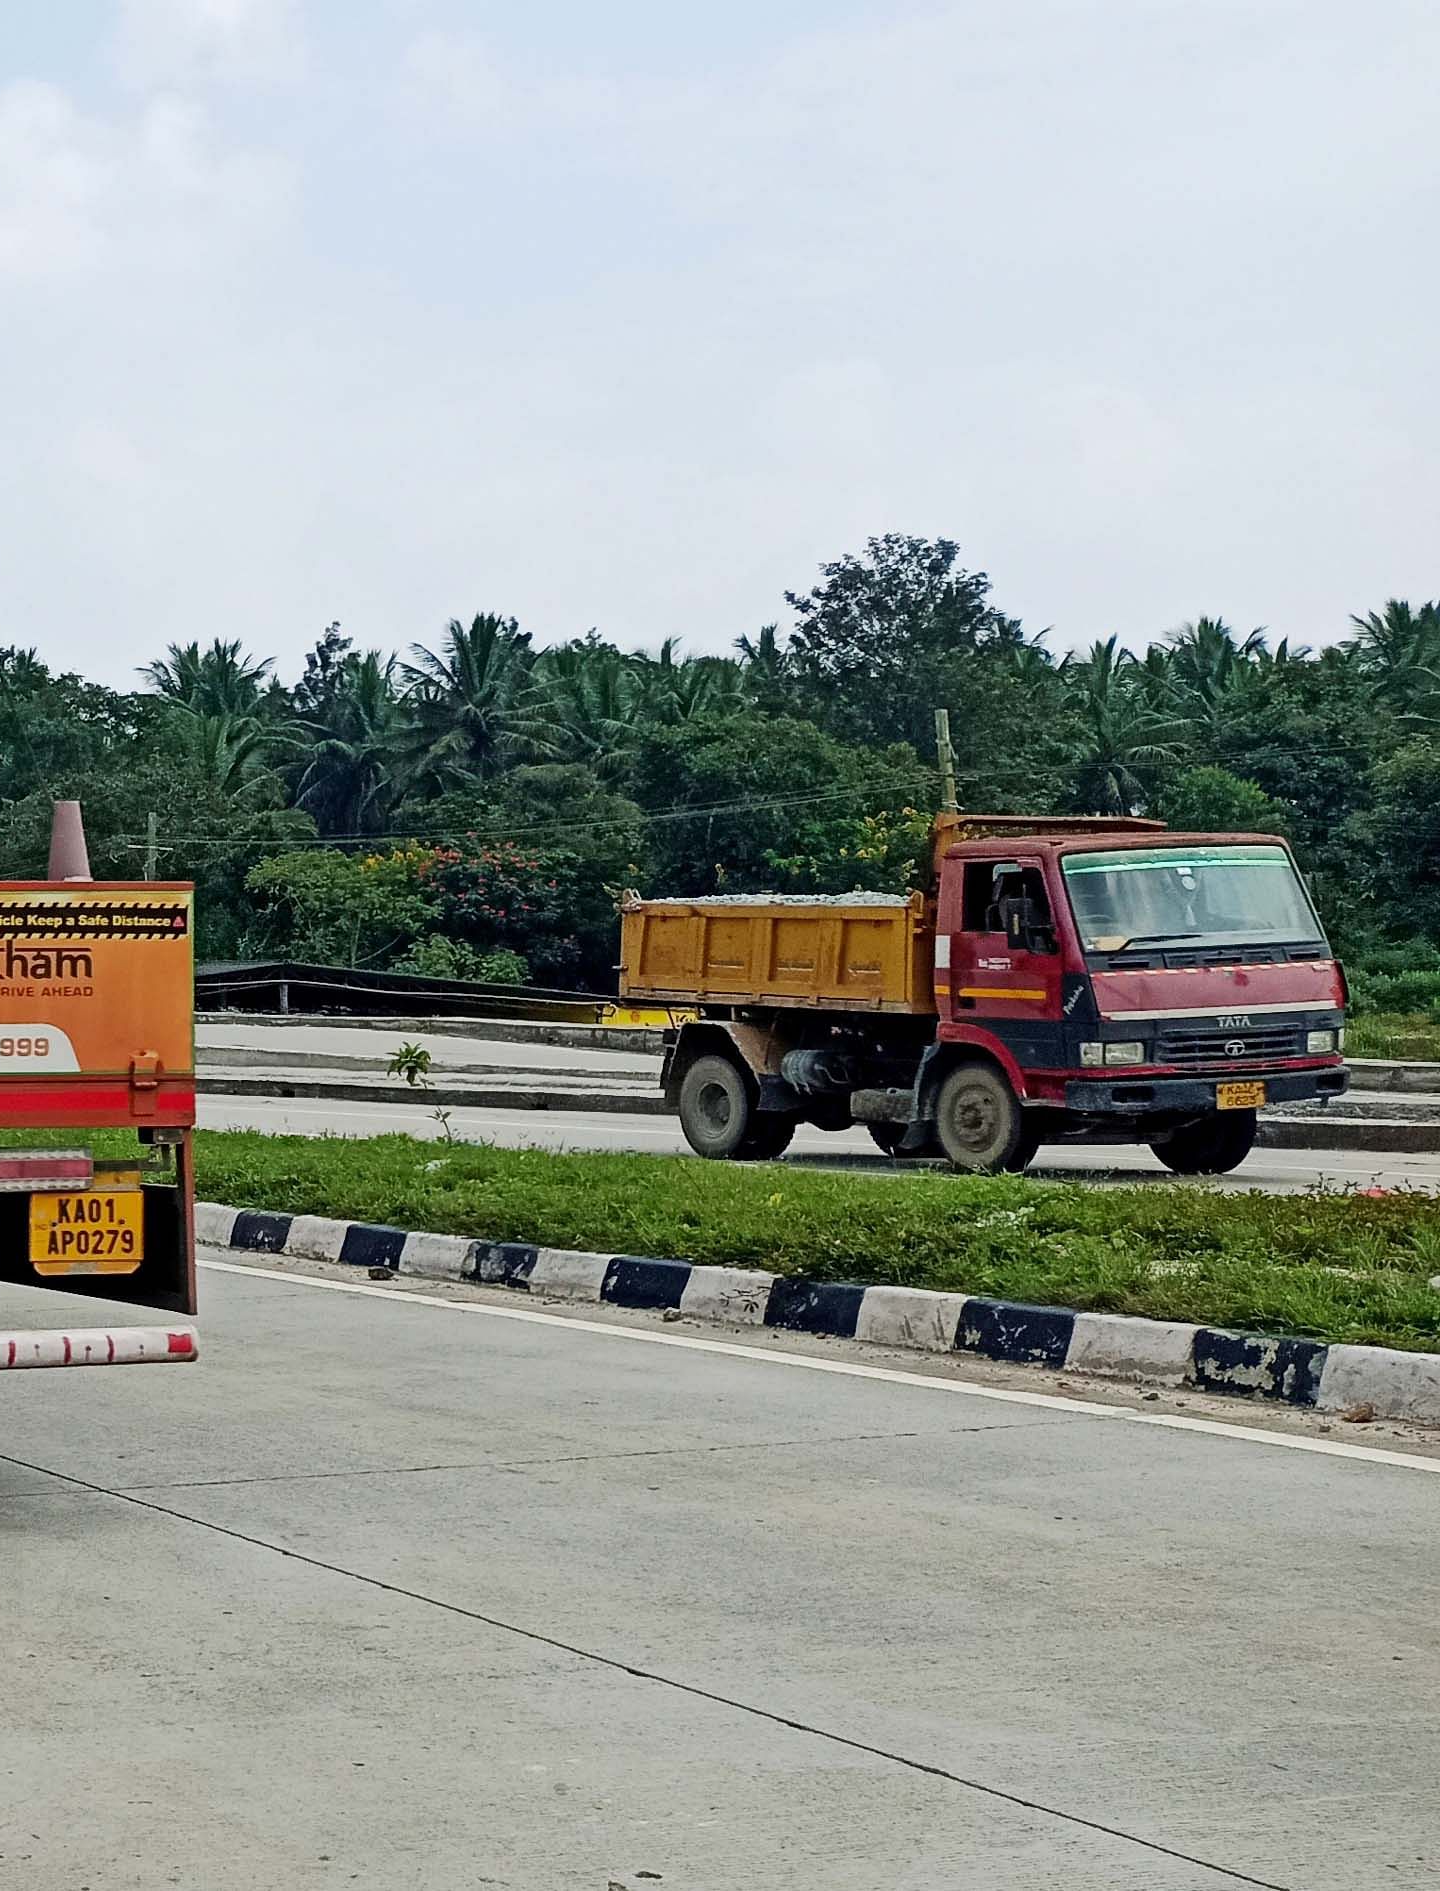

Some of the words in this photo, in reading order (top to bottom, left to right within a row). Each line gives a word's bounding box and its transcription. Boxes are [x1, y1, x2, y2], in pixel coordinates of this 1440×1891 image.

[27, 914, 63, 929] Keep
[66, 917, 76, 927] a
[78, 914, 109, 927] Safe
[112, 914, 172, 927] Distance
[41, 986, 93, 998] AHEAD
[1216, 1015, 1251, 1028] TATA
[0, 1038, 50, 1057] 999
[47, 1229, 135, 1255] AP0279
